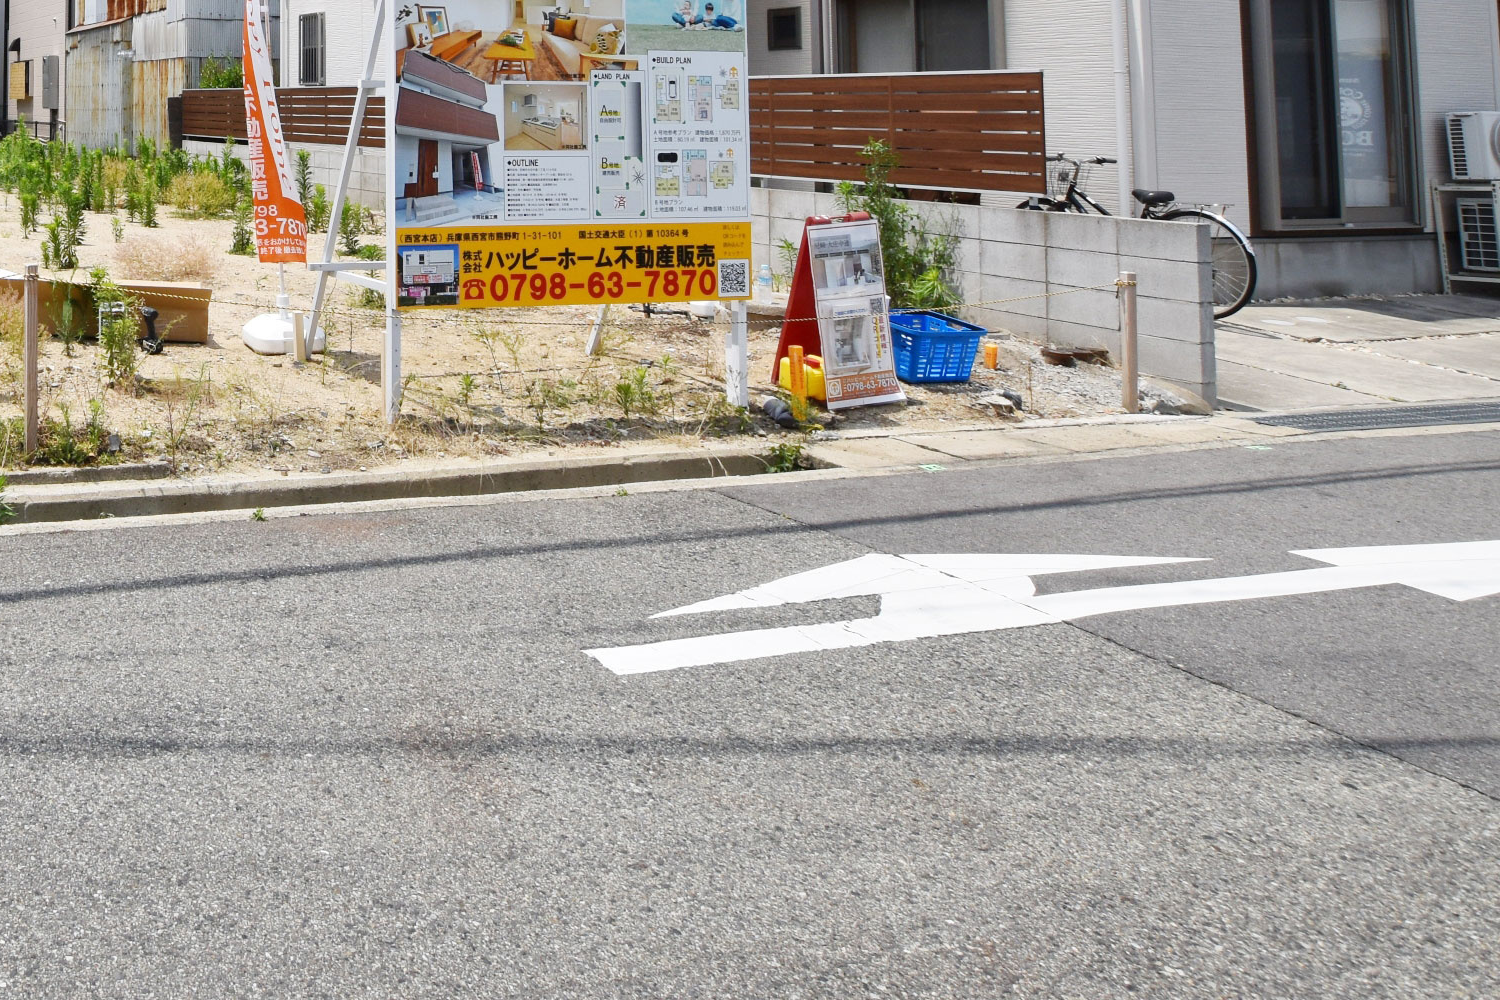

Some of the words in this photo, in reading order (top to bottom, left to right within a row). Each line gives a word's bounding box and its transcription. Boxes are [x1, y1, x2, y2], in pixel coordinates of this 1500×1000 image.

[656, 56, 674, 64] BUILD
[675, 56, 692, 64] PLAN
[597, 72, 612, 80] LAND
[511, 159, 539, 167] OUTLINE
[614, 195, 626, 209] 済
[485, 244, 715, 271] ハッピーホーム不動産販売
[489, 268, 717, 302] 0798-63-7870
